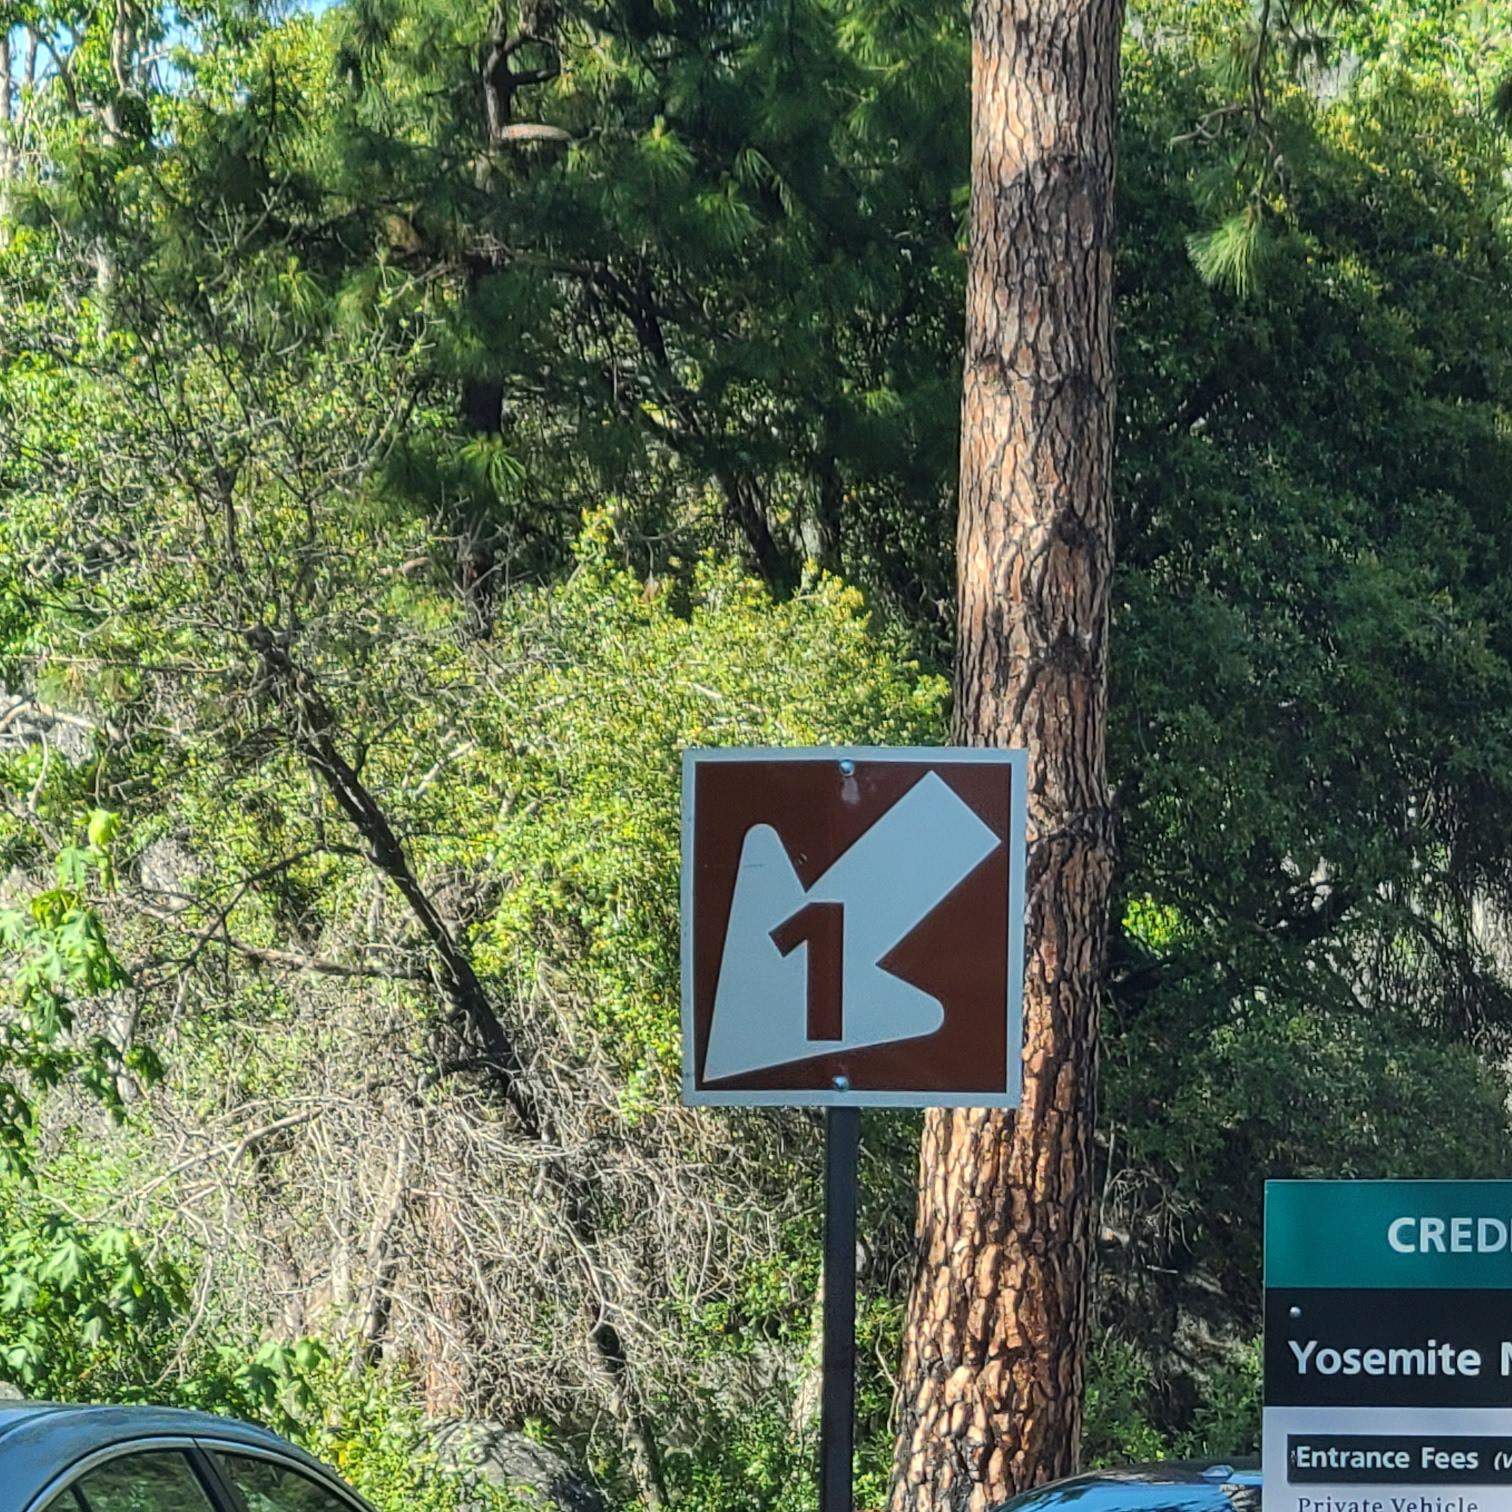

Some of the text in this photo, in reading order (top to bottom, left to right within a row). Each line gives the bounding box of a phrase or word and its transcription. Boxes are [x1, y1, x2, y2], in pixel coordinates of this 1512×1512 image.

[768, 902, 844, 1041] 1
[1289, 1340, 1481, 1377] Yosemite
[1296, 1446, 1410, 1469] Entrance
[1421, 1447, 1478, 1469] Fees
